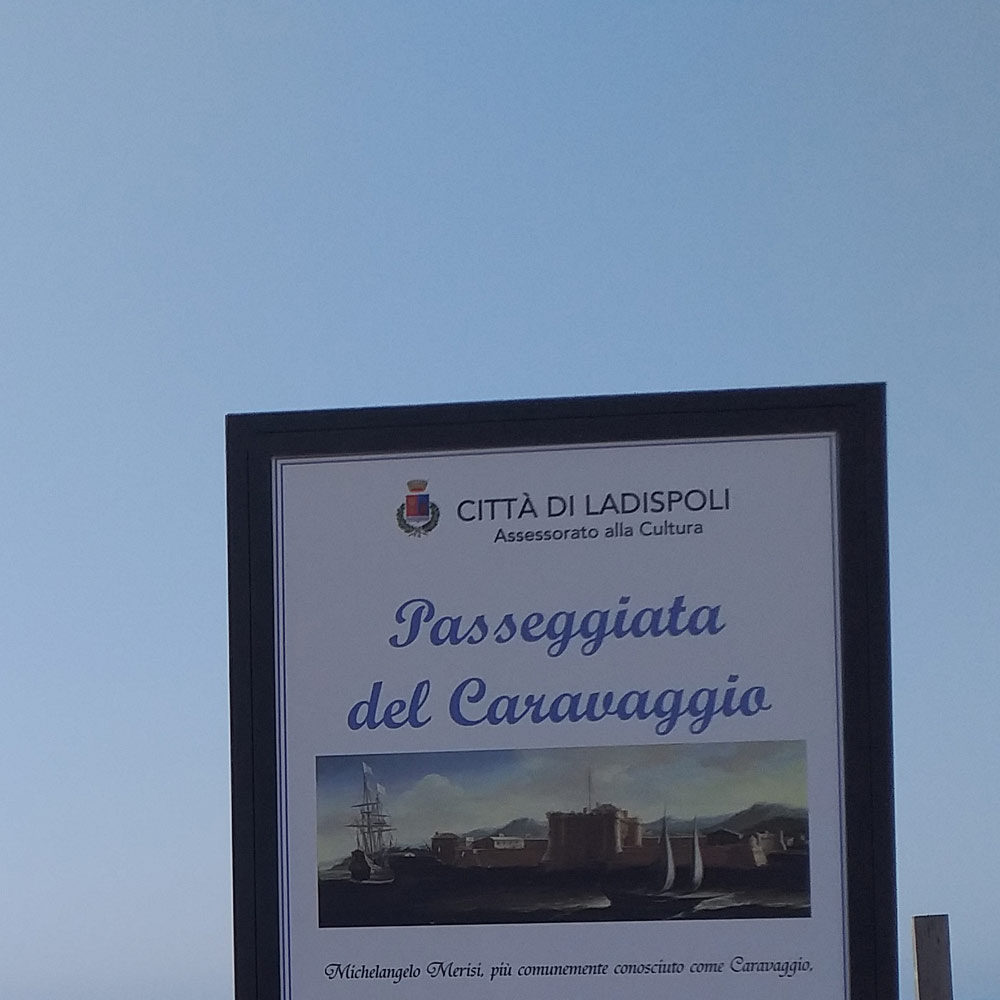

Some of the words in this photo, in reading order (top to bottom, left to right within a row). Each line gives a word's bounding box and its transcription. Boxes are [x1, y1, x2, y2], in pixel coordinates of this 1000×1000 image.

[457, 492, 538, 521] CITTÀ
[548, 495, 574, 517] DI
[586, 488, 729, 516] LADISPOLI
[494, 526, 599, 543] Assessorato
[605, 522, 633, 538] alla
[640, 520, 703, 536] Cultura
[389, 595, 726, 657] Passeggiata
[348, 680, 431, 730] del
[449, 675, 772, 735] Caravaggio
[325, 964, 421, 984] Michelangelo
[427, 962, 484, 978] Merisi,
[490, 962, 512, 981] più
[518, 964, 608, 976] comunemente
[614, 960, 684, 974] conosciuto
[690, 963, 724, 973] come
